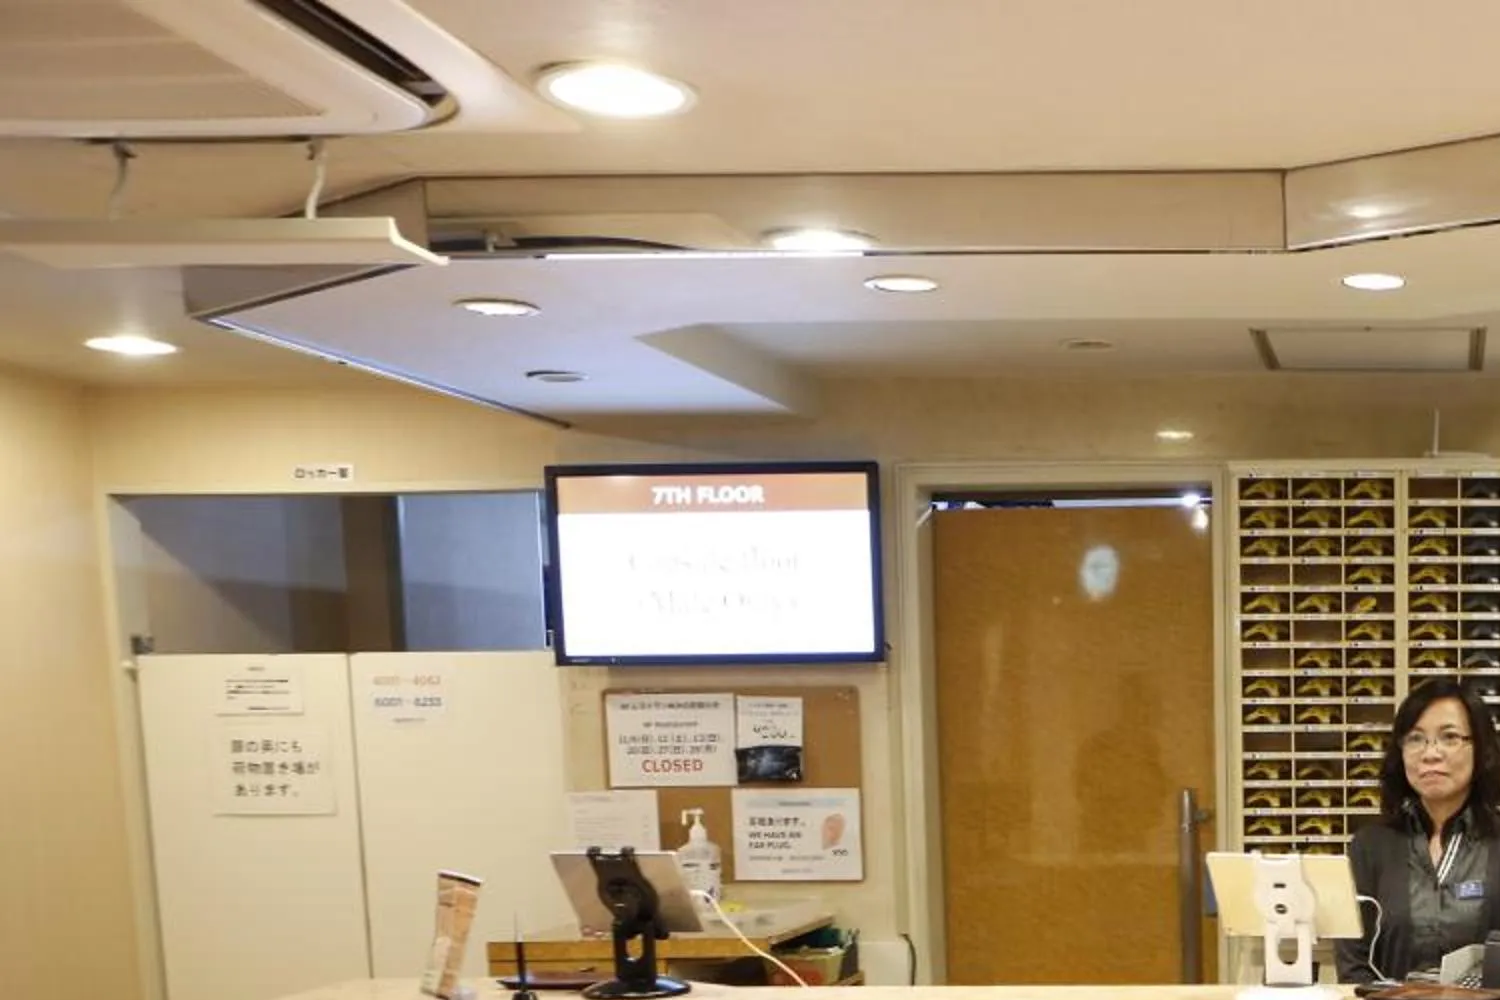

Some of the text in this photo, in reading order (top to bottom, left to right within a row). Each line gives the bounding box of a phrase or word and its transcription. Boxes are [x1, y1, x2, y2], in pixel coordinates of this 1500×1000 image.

[651, 485, 765, 504] 7TH FLOOR
[641, 759, 703, 773] CLOSED
